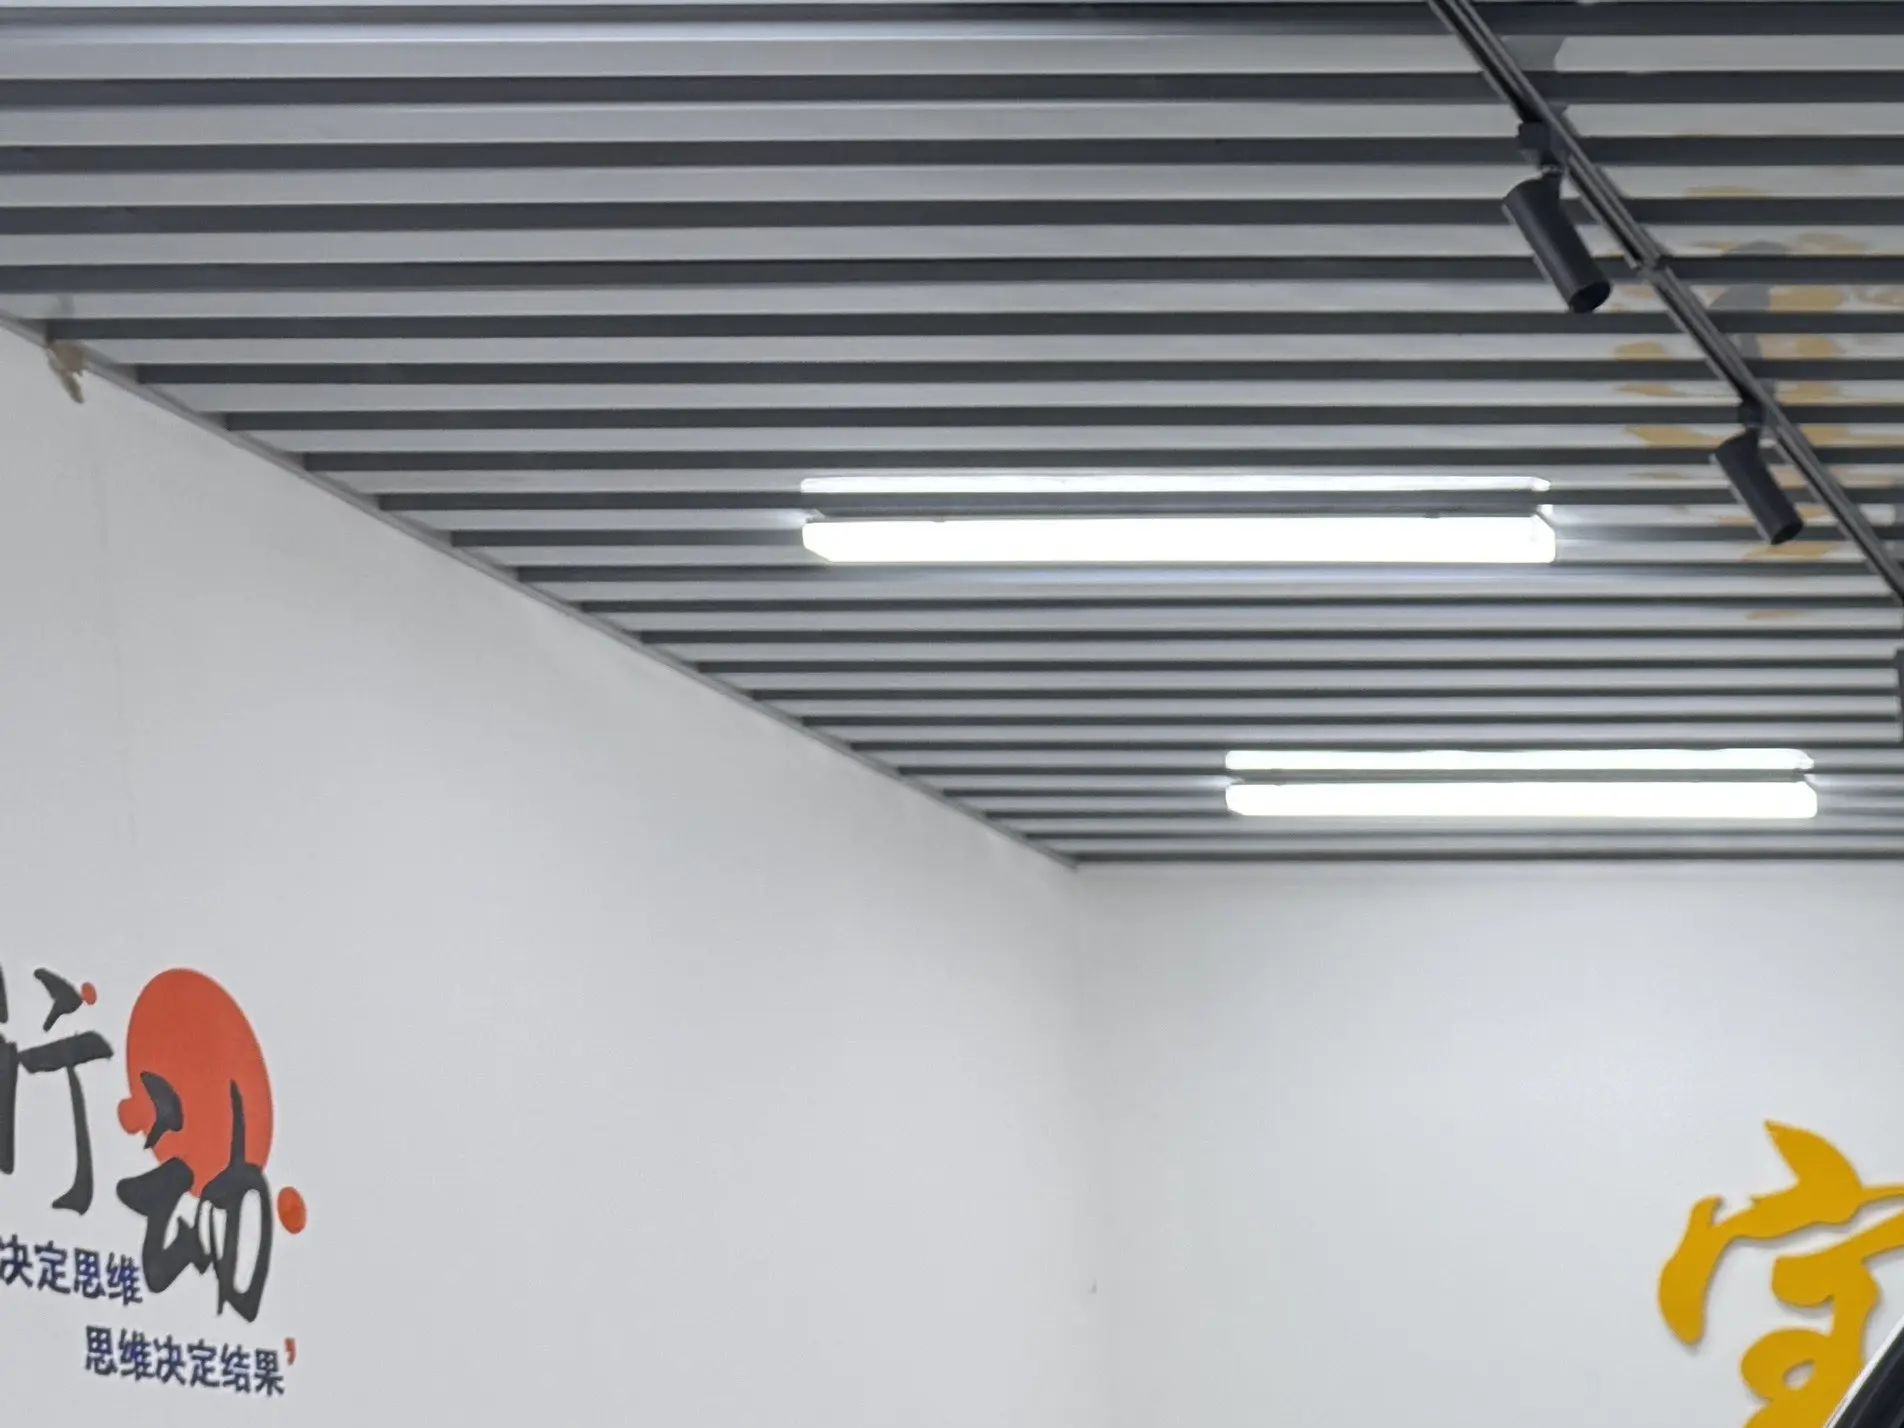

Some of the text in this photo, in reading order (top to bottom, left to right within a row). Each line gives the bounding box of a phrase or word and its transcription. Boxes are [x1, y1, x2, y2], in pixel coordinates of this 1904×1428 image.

[84, 1324, 285, 1397] 思维决定结果
